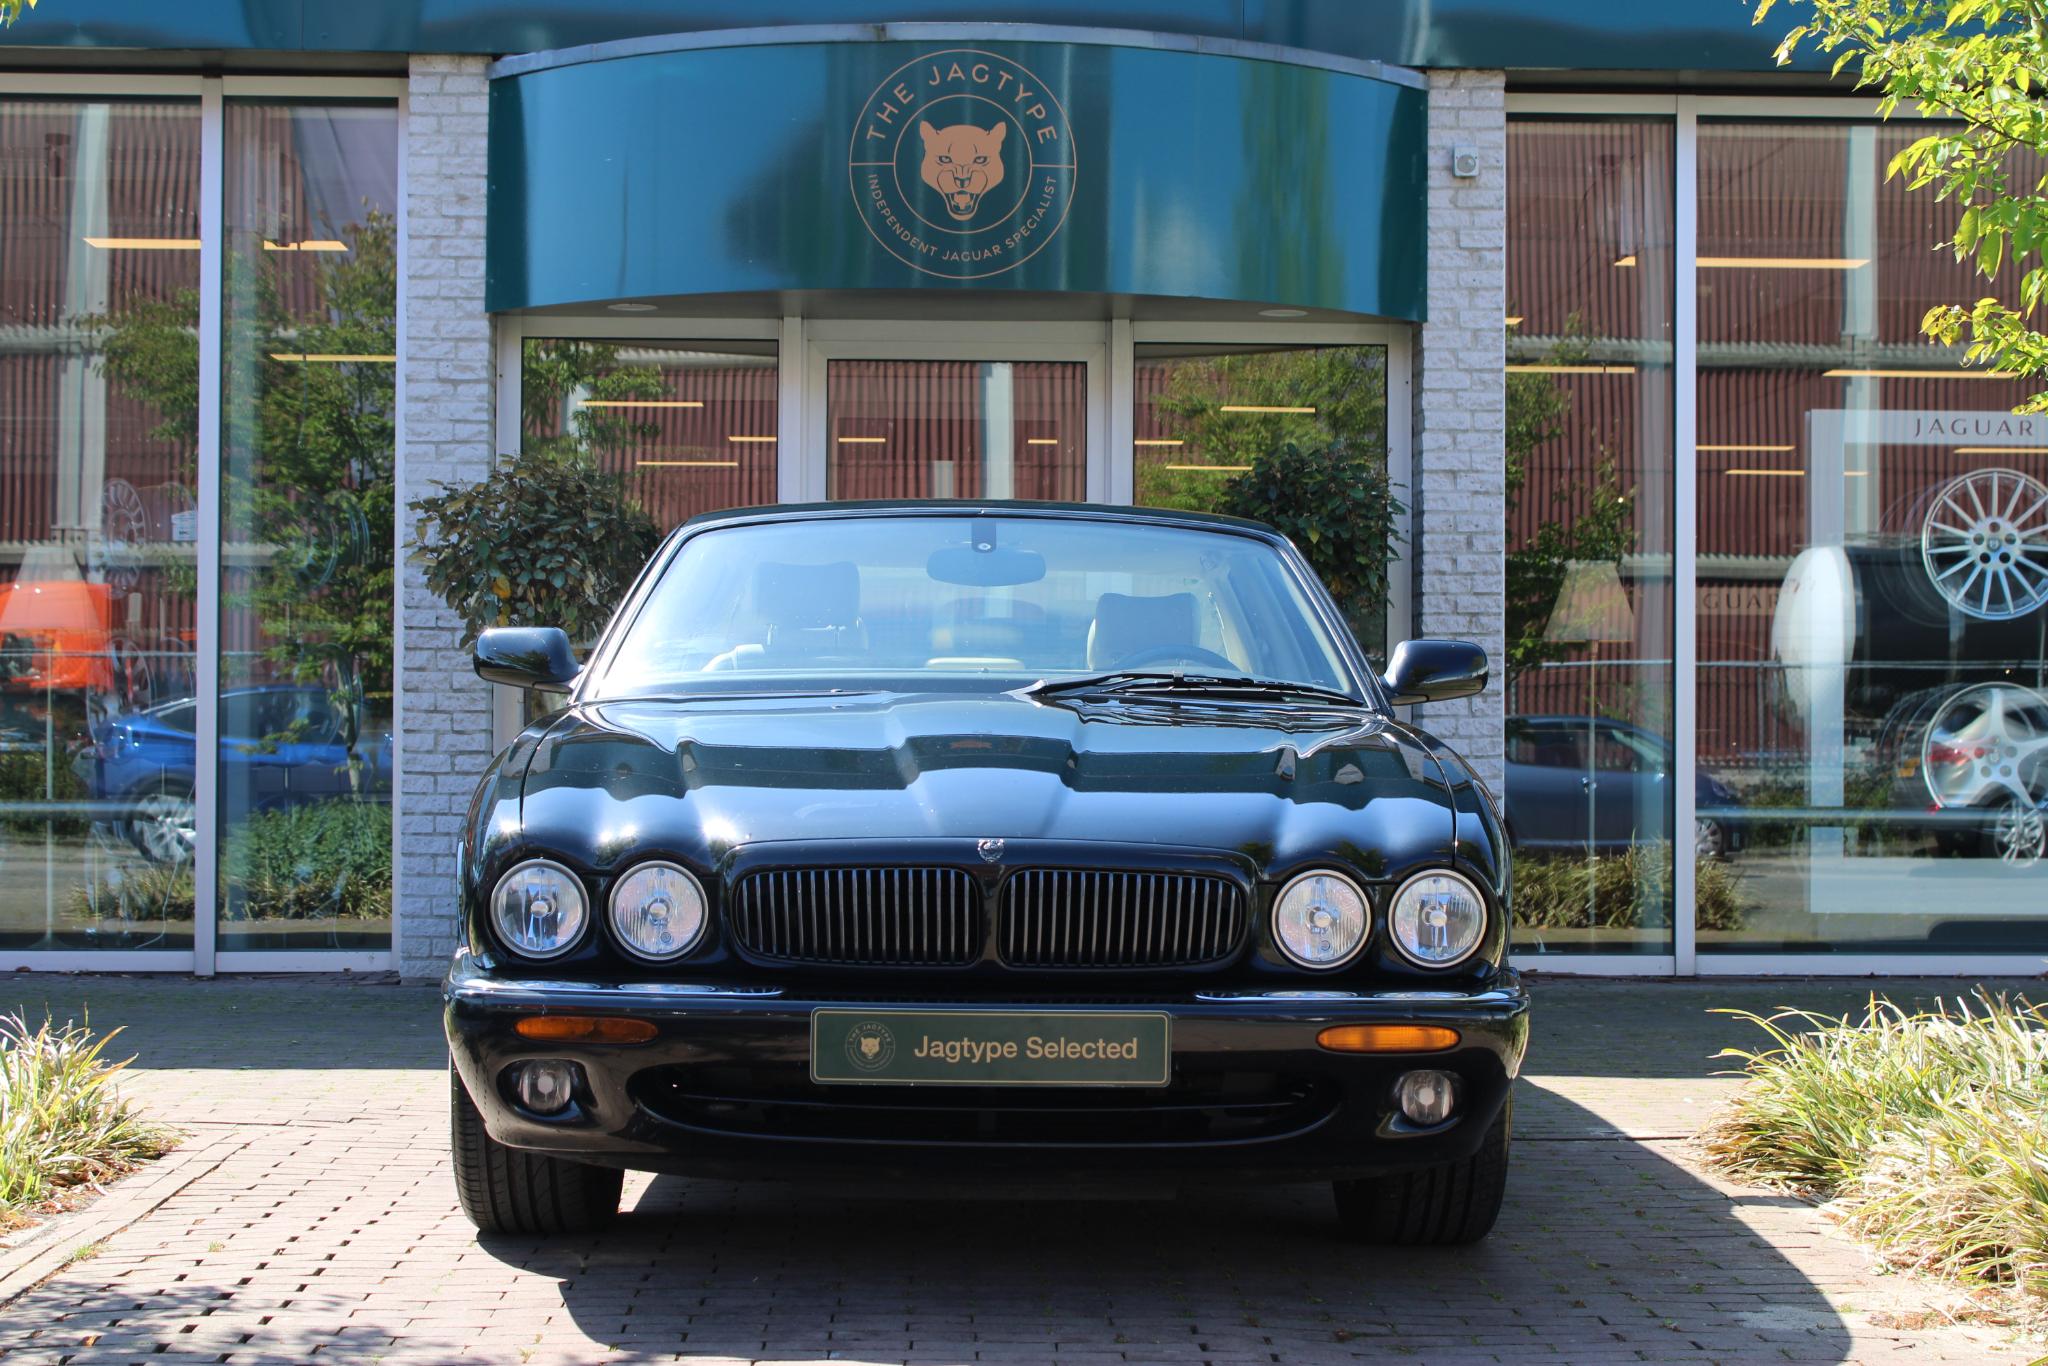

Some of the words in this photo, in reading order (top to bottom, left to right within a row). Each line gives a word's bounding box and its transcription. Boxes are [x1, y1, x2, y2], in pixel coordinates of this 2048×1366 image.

[866, 82, 915, 141] THE
[928, 62, 1058, 145] JAGTYPE
[867, 173, 939, 257] INDEPENDENT
[942, 244, 1003, 262] JAGUAR
[1005, 176, 1058, 249] SPECIALIST
[1914, 417, 2035, 437] JAGUAR
[913, 1035, 1018, 1063] Jagtype
[1025, 1036, 1138, 1060] Selected
